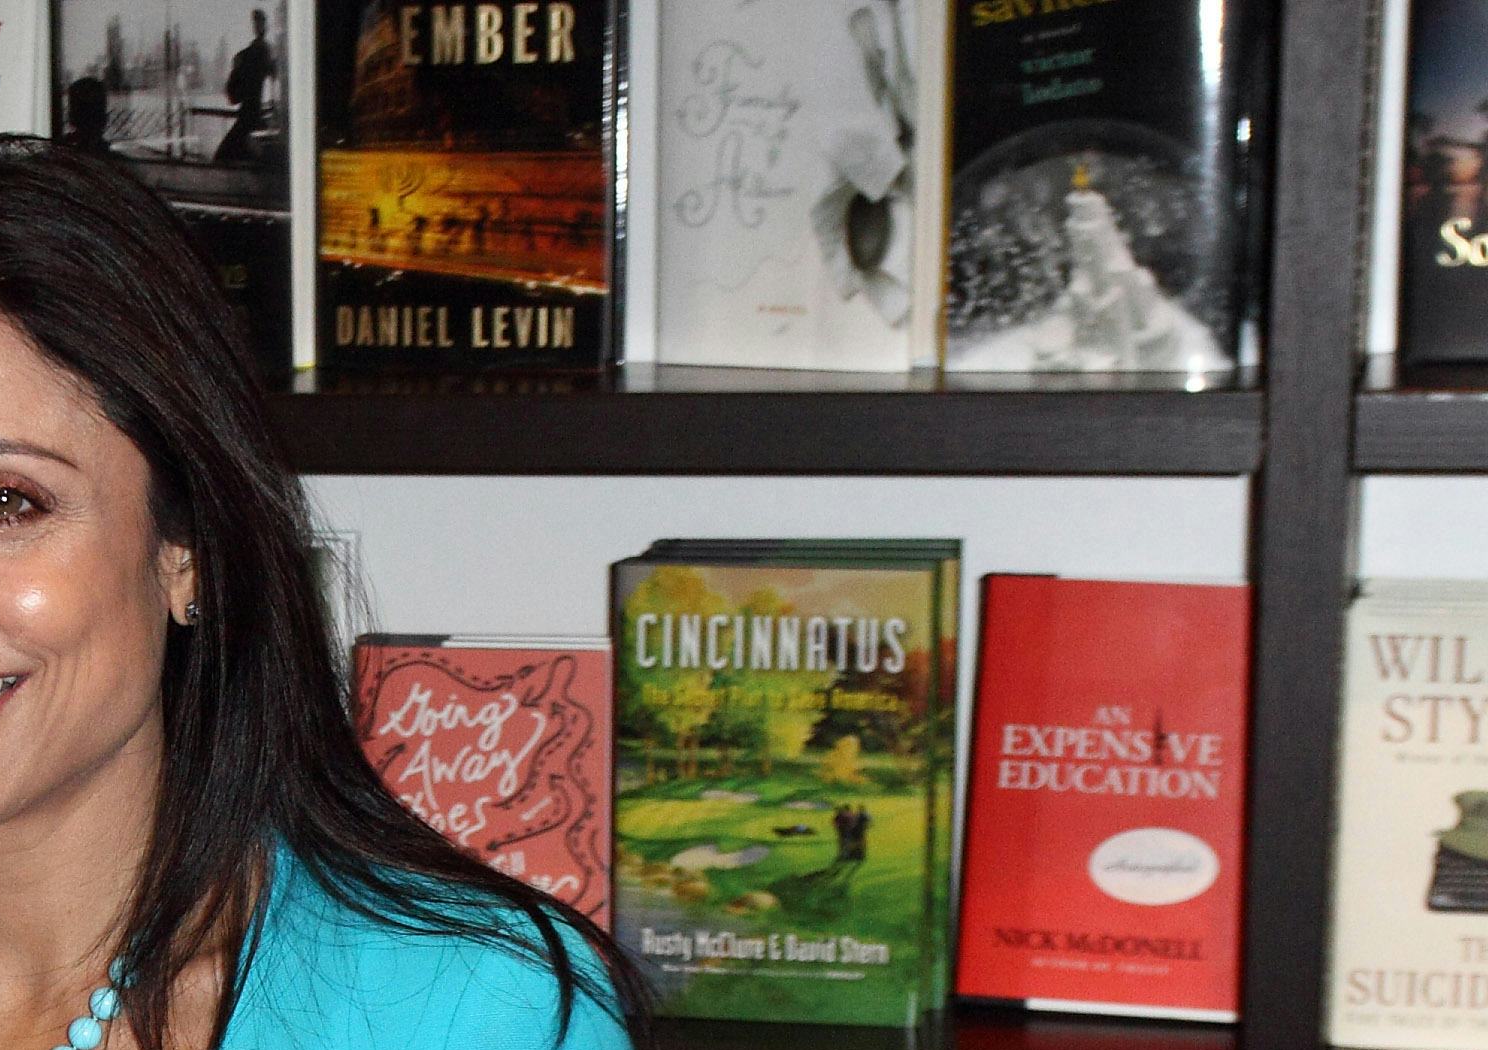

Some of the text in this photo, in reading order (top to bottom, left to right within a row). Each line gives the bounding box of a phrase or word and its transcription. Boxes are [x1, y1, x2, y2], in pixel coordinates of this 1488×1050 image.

[400, 3, 575, 66] EMBER
[335, 304, 575, 349] DANIEL LEVIN
[635, 613, 907, 673] CINCINNATUS
[378, 682, 518, 750] Going
[398, 711, 547, 810] Away
[997, 759, 1221, 799] EDUCATION
